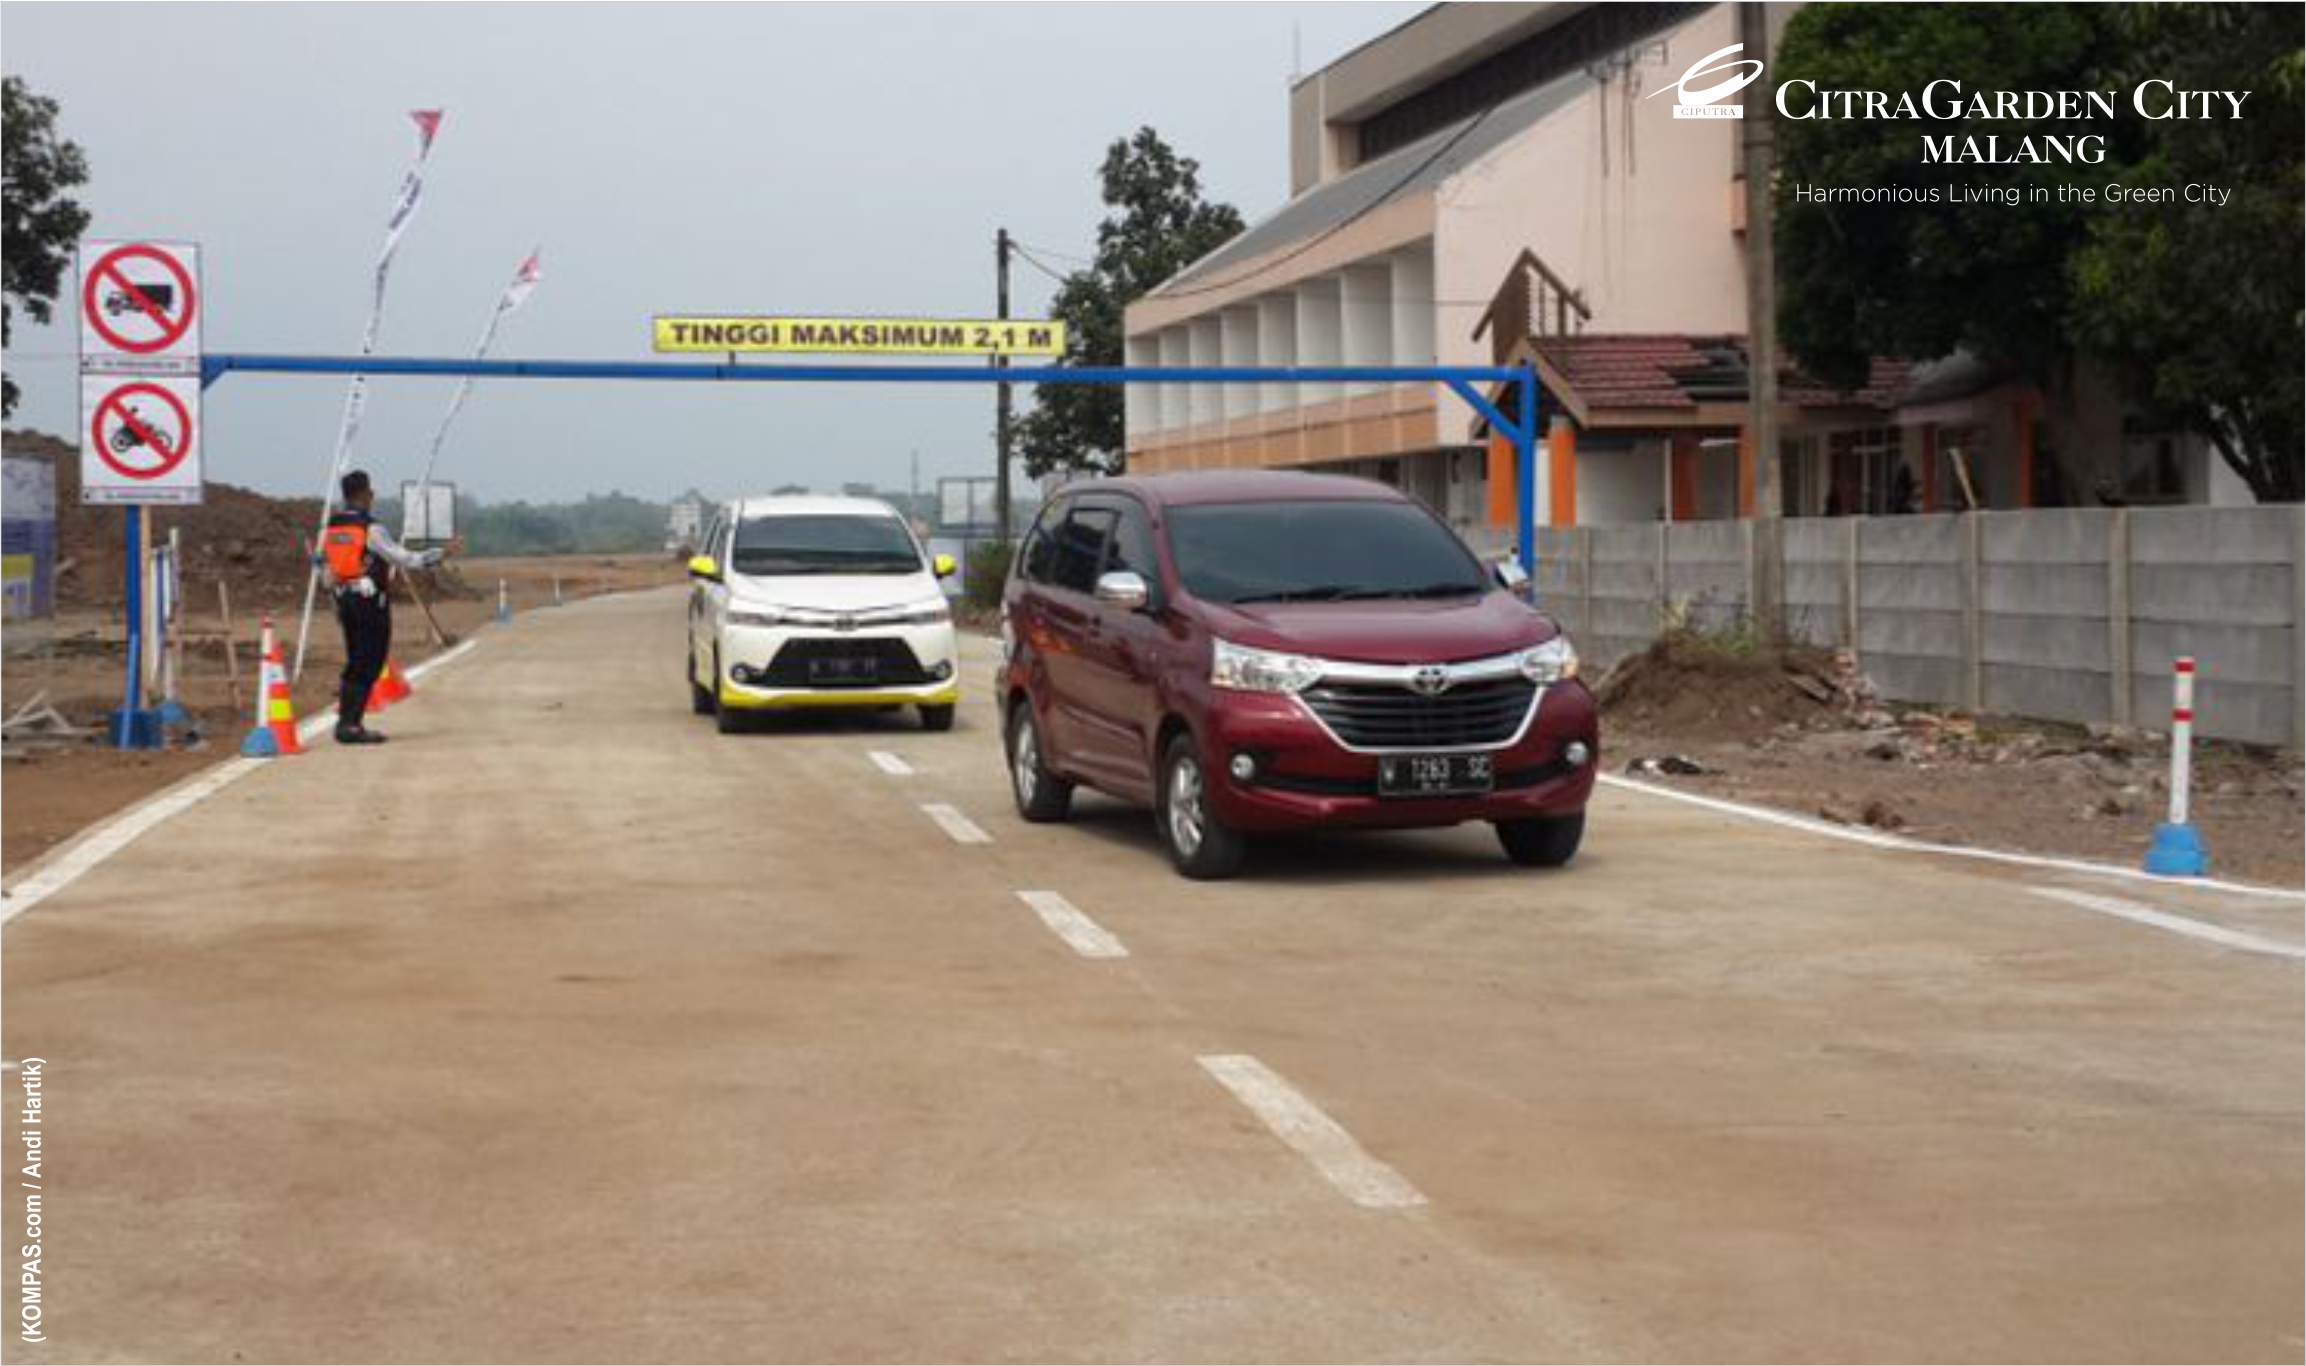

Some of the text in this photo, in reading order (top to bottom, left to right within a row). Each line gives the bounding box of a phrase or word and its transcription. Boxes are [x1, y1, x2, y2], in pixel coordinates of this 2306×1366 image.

[670, 323, 1053, 350] TINGGI MAKSIMUM 2,1 M
